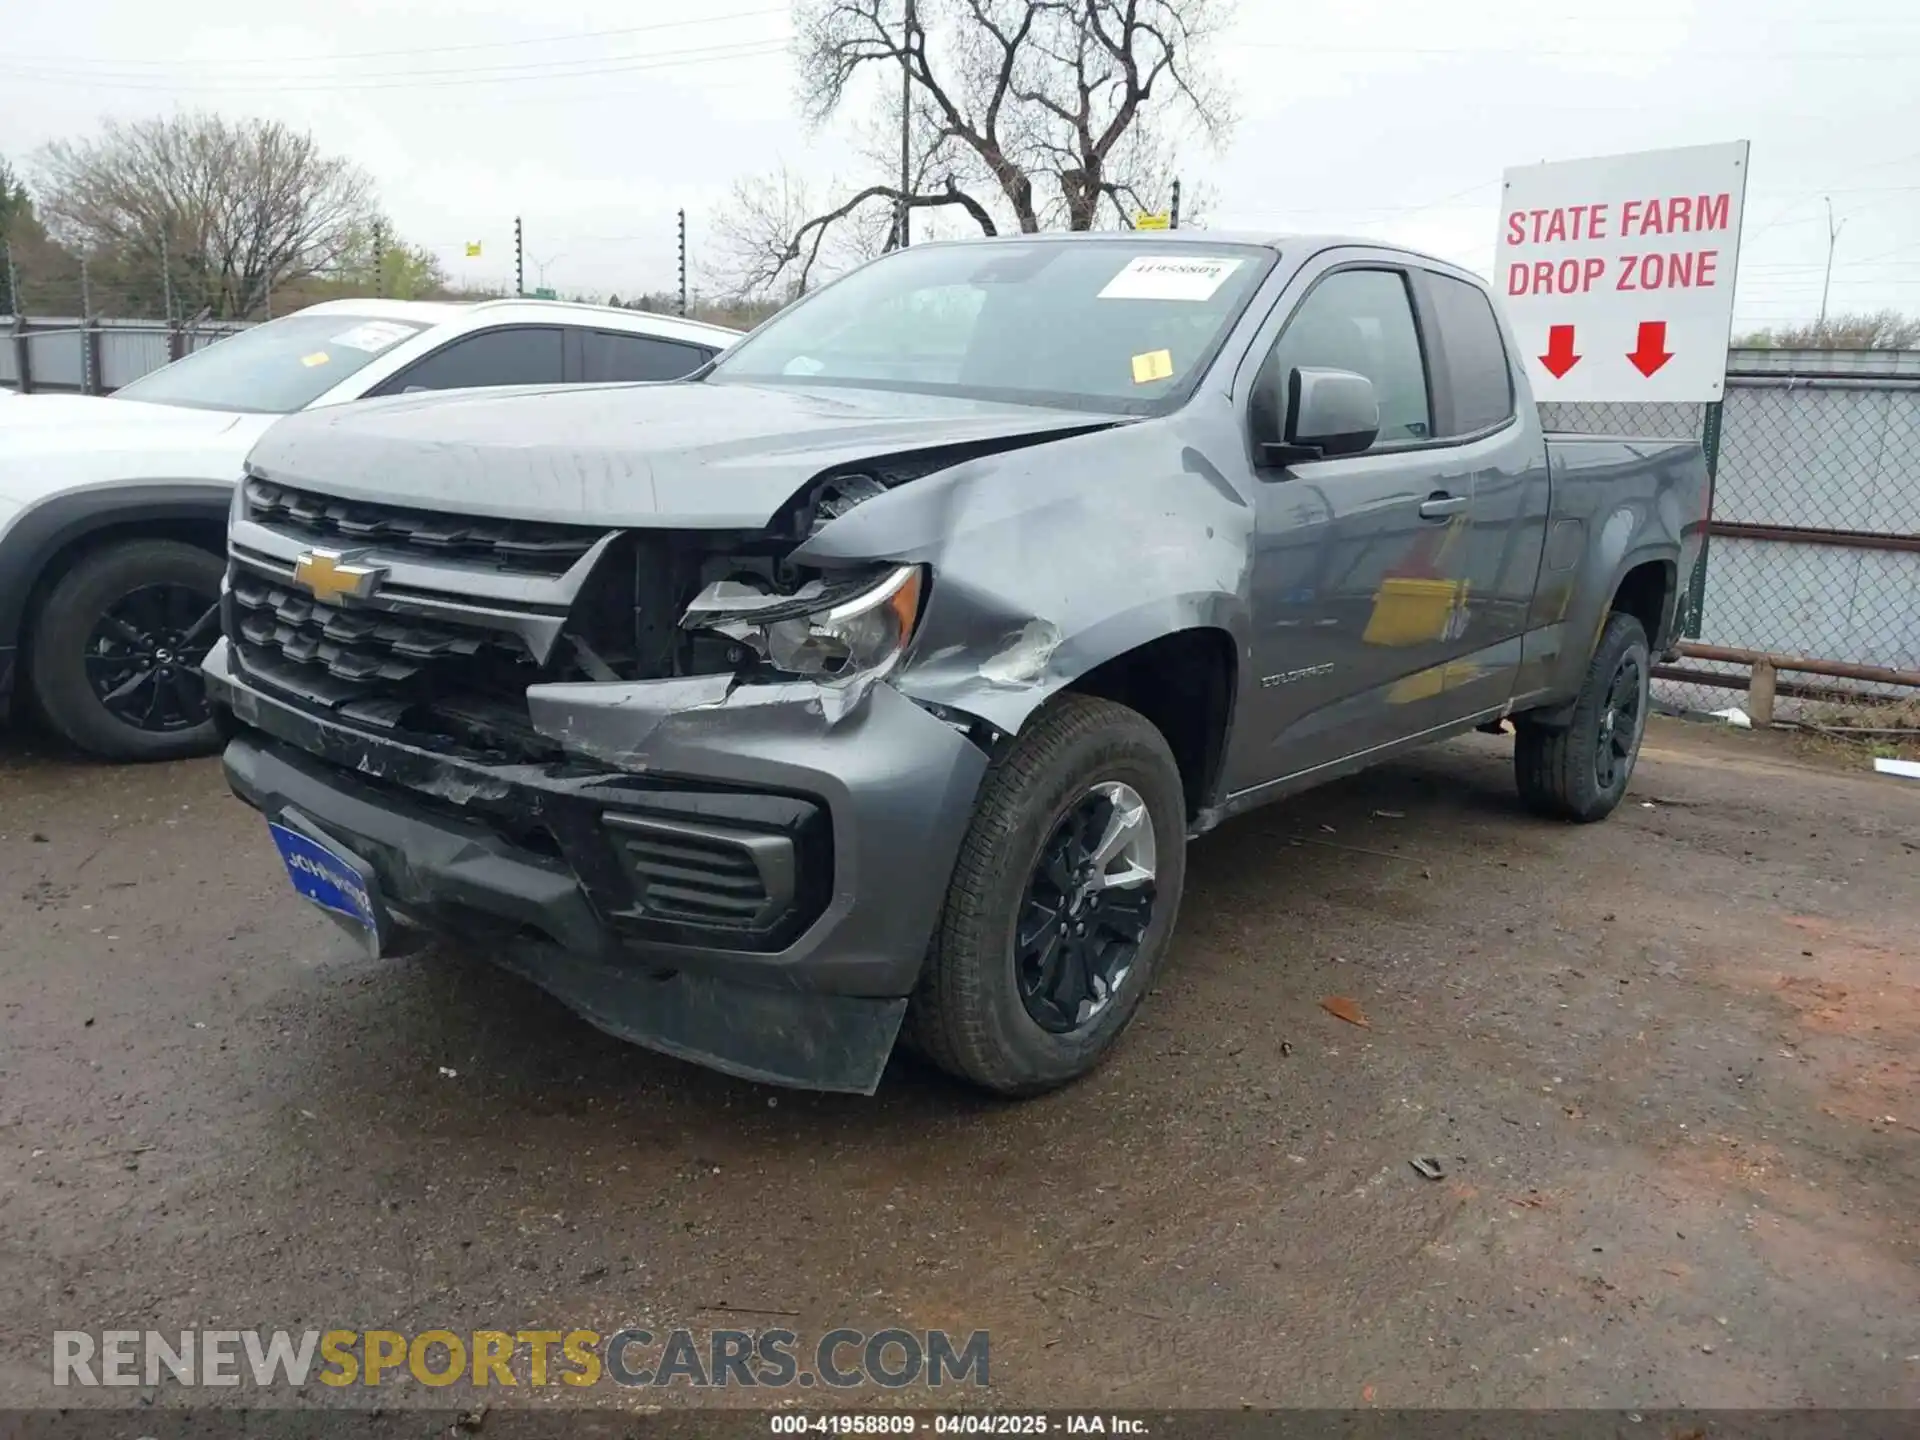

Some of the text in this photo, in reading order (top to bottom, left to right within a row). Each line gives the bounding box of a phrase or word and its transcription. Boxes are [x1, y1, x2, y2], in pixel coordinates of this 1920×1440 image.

[1506, 193, 1731, 246] STATE FARM
[1508, 250, 1718, 296] DROP ZONE
